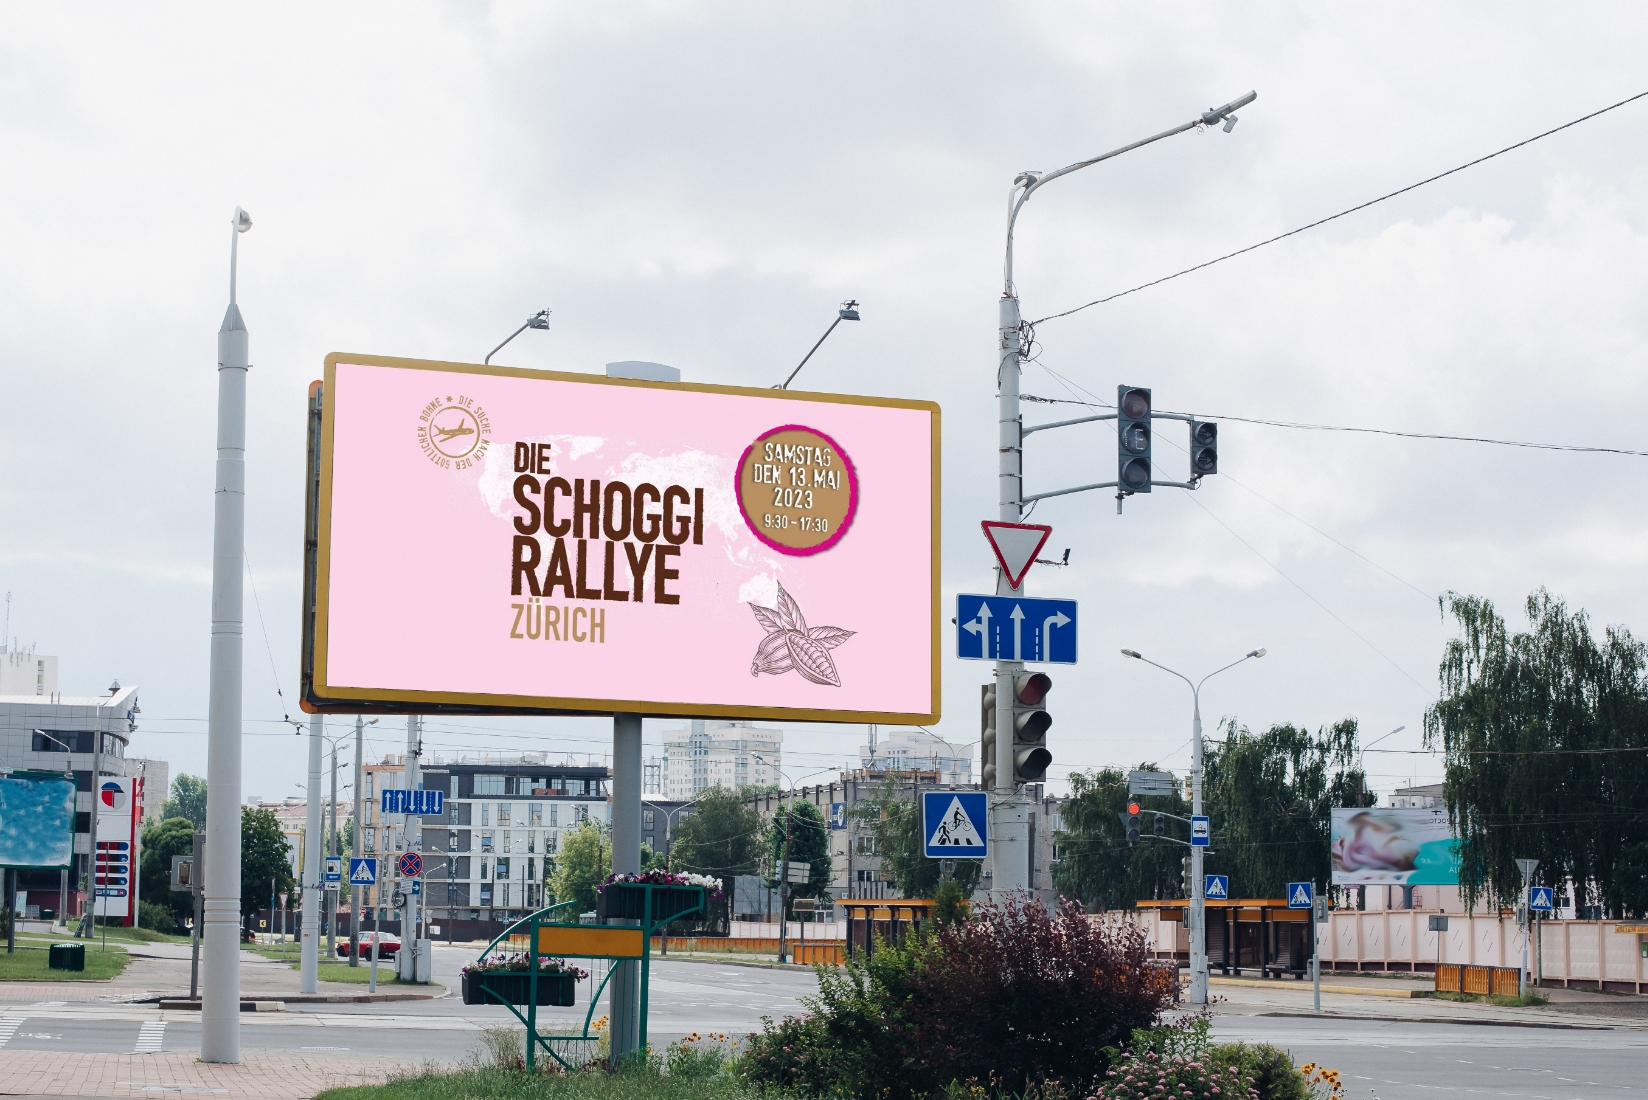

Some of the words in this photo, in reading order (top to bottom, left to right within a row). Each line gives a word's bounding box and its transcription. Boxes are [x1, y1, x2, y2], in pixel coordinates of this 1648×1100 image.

[419, 397, 443, 422] BOHNE
[459, 395, 474, 408] DIE
[474, 407, 491, 434] SUCHE
[472, 439, 491, 461] NACH
[514, 441, 551, 475] DIE
[764, 442, 831, 467] SAMSTAG
[455, 457, 473, 470] DER
[754, 463, 781, 484] DEN
[513, 474, 704, 545] SCHOGGI
[774, 487, 813, 509] 2023
[510, 535, 681, 605] RALLYE
[510, 597, 605, 643] ZÜRICH
